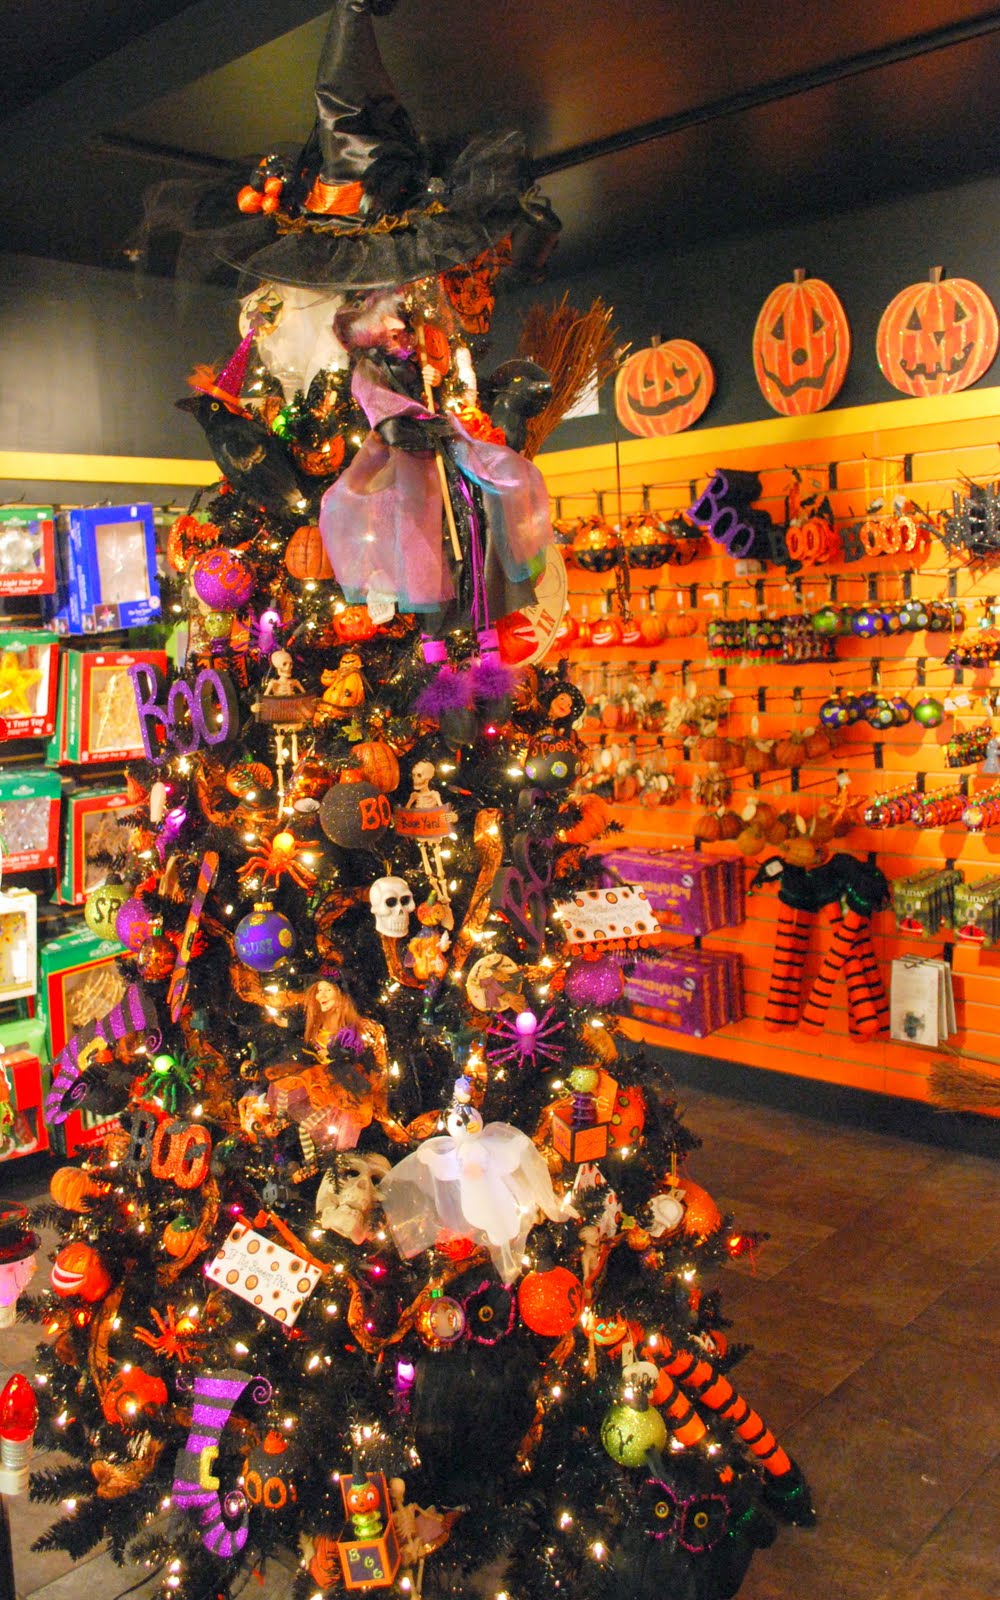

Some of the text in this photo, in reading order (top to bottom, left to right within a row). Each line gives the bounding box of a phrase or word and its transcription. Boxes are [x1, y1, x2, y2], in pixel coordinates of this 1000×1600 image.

[687, 468, 755, 559] BOO
[127, 662, 231, 765] BOO
[125, 1109, 212, 1190] BOO
